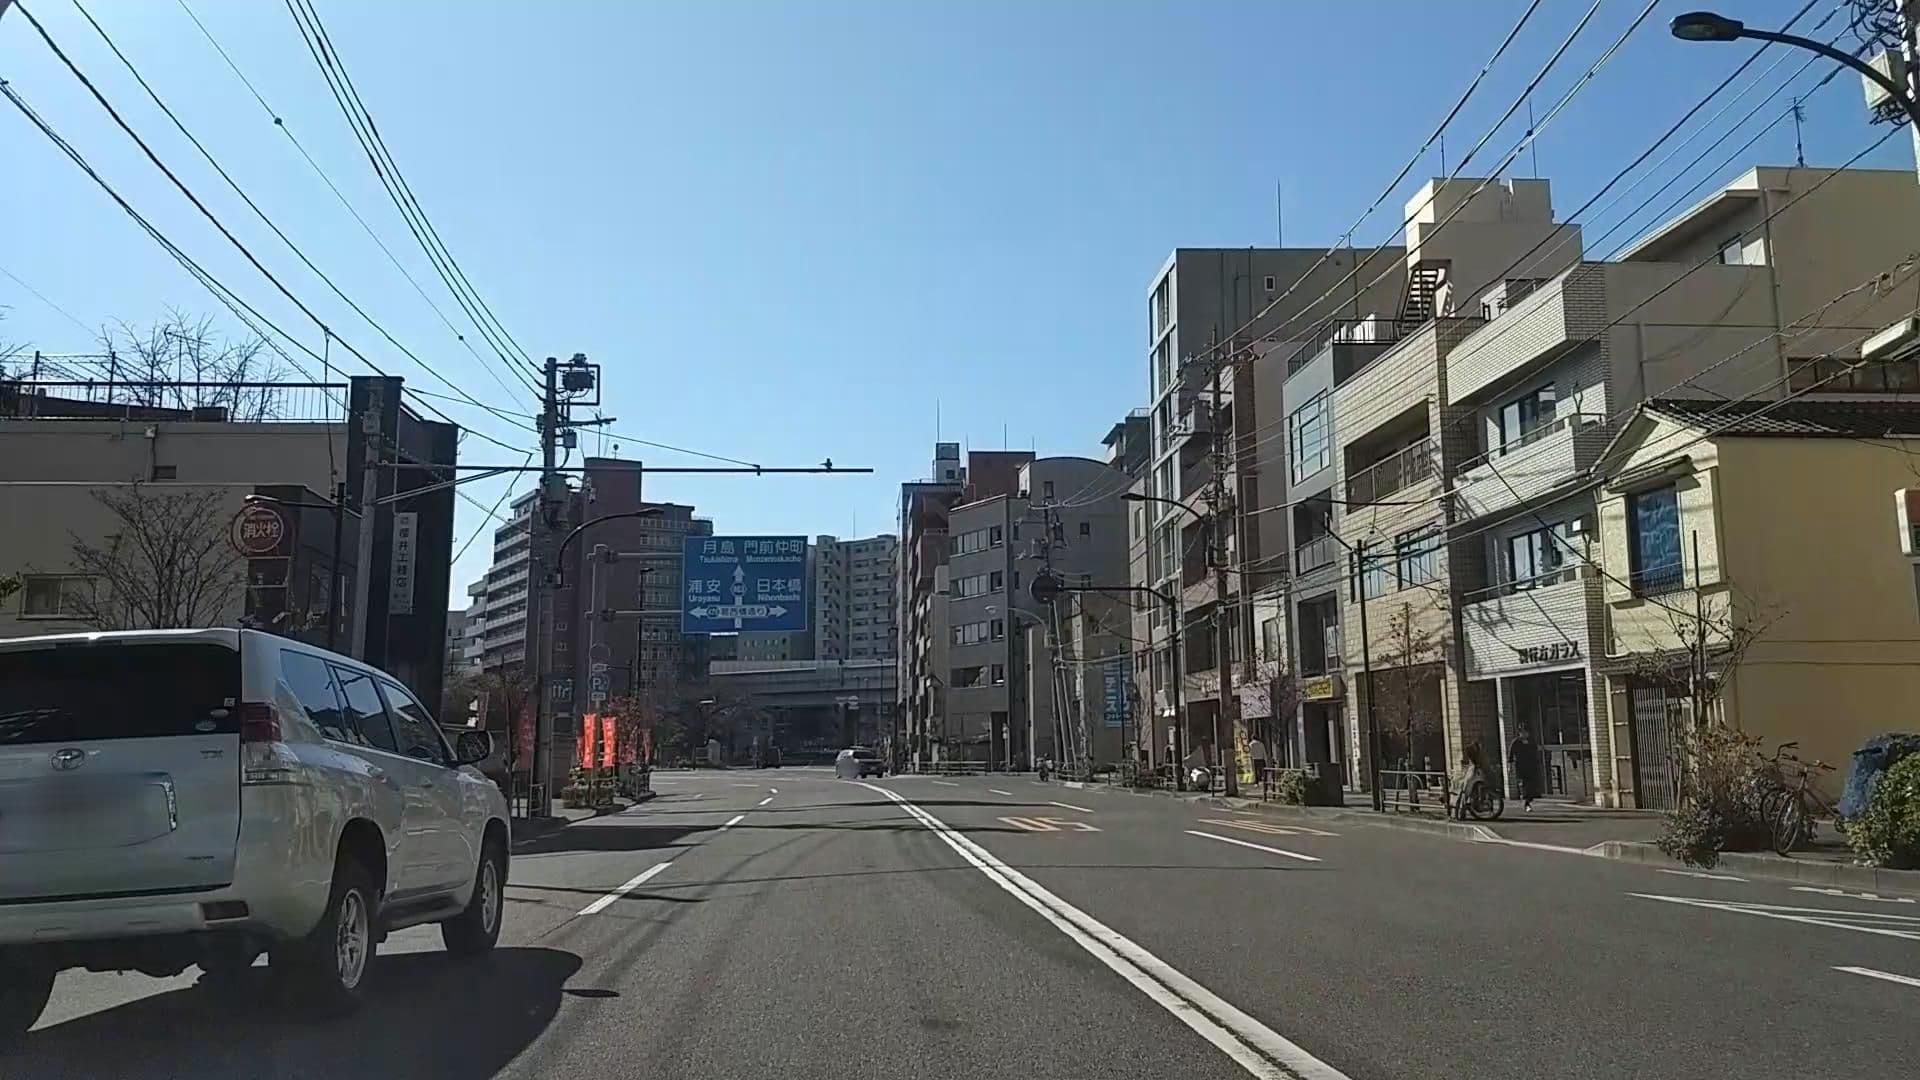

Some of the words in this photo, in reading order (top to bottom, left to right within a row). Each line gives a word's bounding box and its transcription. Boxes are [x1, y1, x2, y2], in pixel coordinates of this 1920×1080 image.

[244, 521, 279, 538] 消火栓
[703, 540, 735, 554] 月島
[744, 540, 804, 554] 門前仲町
[688, 579, 721, 593] 浦安
[757, 578, 801, 593] 日本橋
